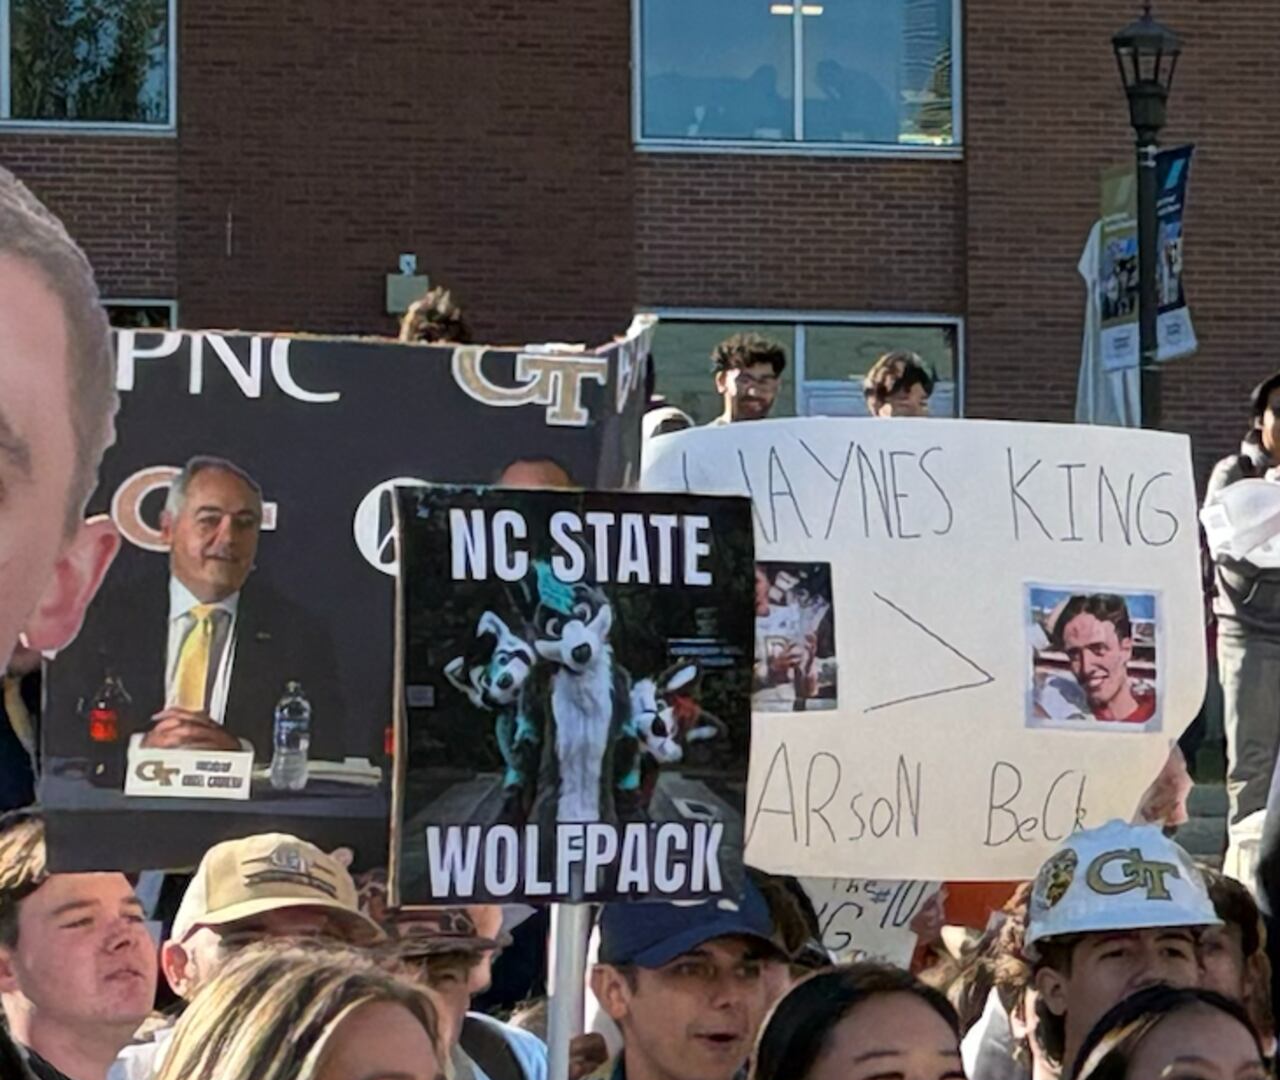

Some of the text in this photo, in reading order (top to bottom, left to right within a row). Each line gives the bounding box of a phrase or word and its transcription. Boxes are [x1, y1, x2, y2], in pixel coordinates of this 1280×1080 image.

[114, 331, 341, 403] PNC
[1007, 446, 1179, 547] KING
[449, 508, 713, 585] NC STATE
[426, 820, 725, 898] WOLFPACK
[1085, 847, 1182, 901] GT
